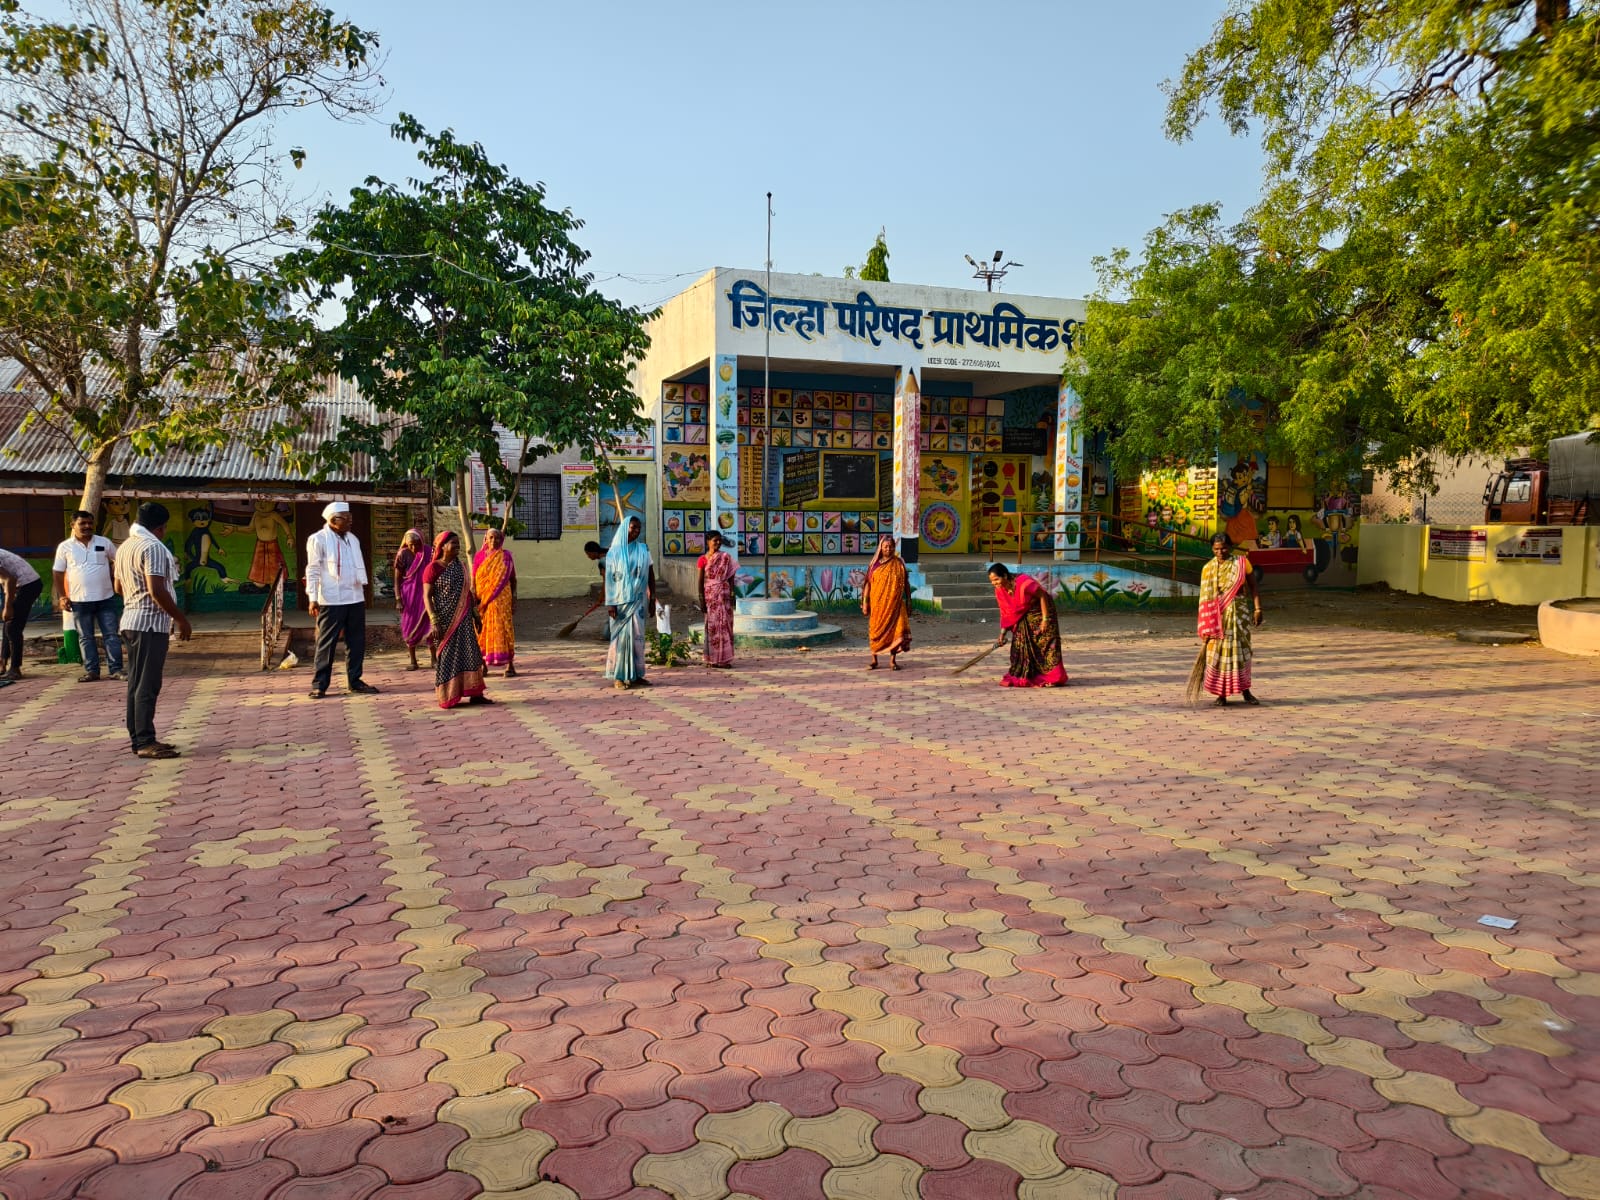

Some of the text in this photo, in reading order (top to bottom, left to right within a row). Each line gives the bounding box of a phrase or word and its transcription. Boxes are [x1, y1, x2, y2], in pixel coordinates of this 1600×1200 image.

[727, 279, 829, 340] जिल्हा
[832, 291, 922, 349] परिषद
[928, 302, 1060, 351] प्राथमिक
[944, 357, 958, 366] CODE
